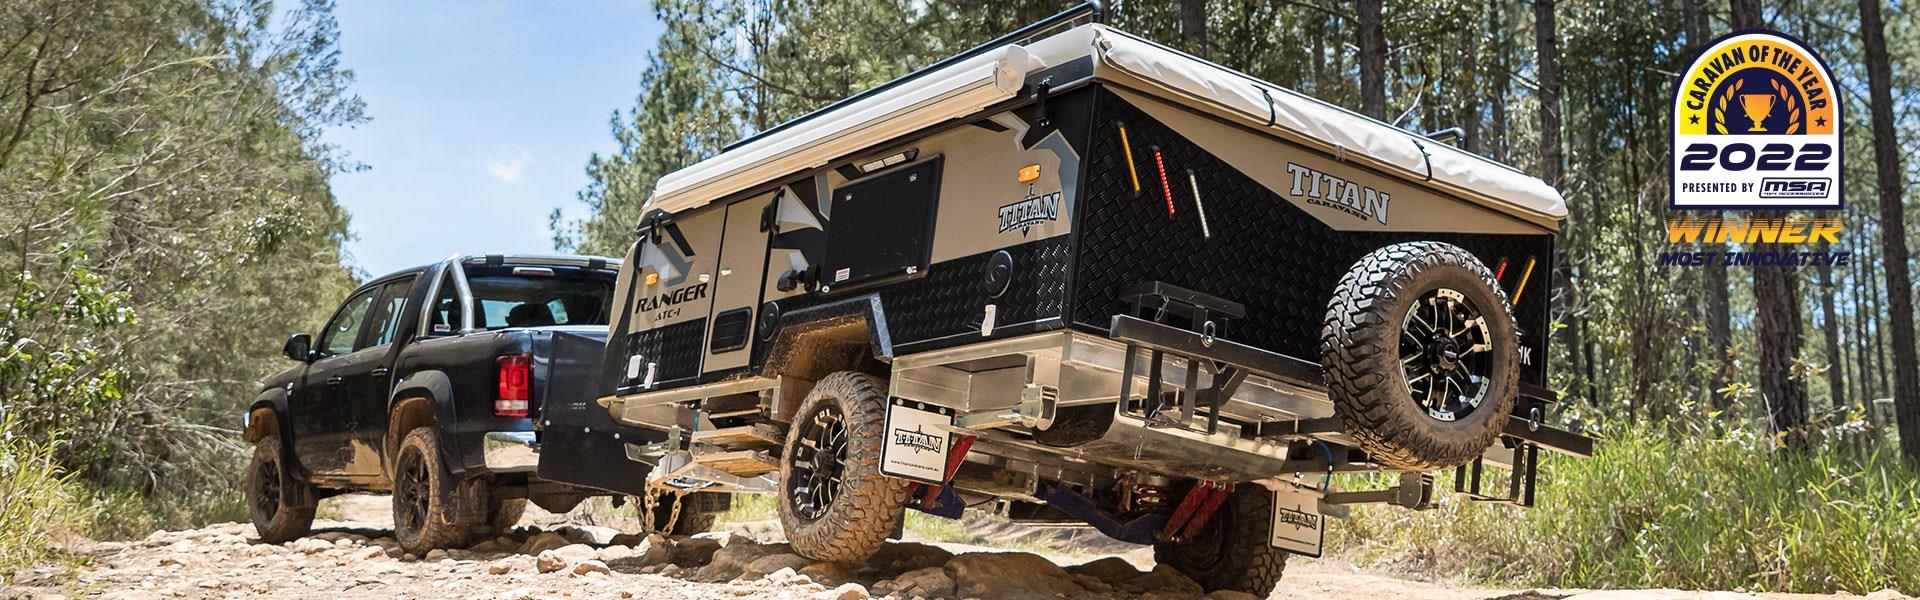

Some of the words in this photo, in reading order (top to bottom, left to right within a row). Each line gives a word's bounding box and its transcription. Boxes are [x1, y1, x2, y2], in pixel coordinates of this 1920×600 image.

[1287, 161, 1391, 226] TITAN
[998, 191, 1061, 234] TITAN
[1306, 199, 1368, 221] CARAVANS
[635, 283, 708, 314] RANGER
[894, 428, 943, 454] TITAN
[1280, 508, 1318, 530] TITAN
